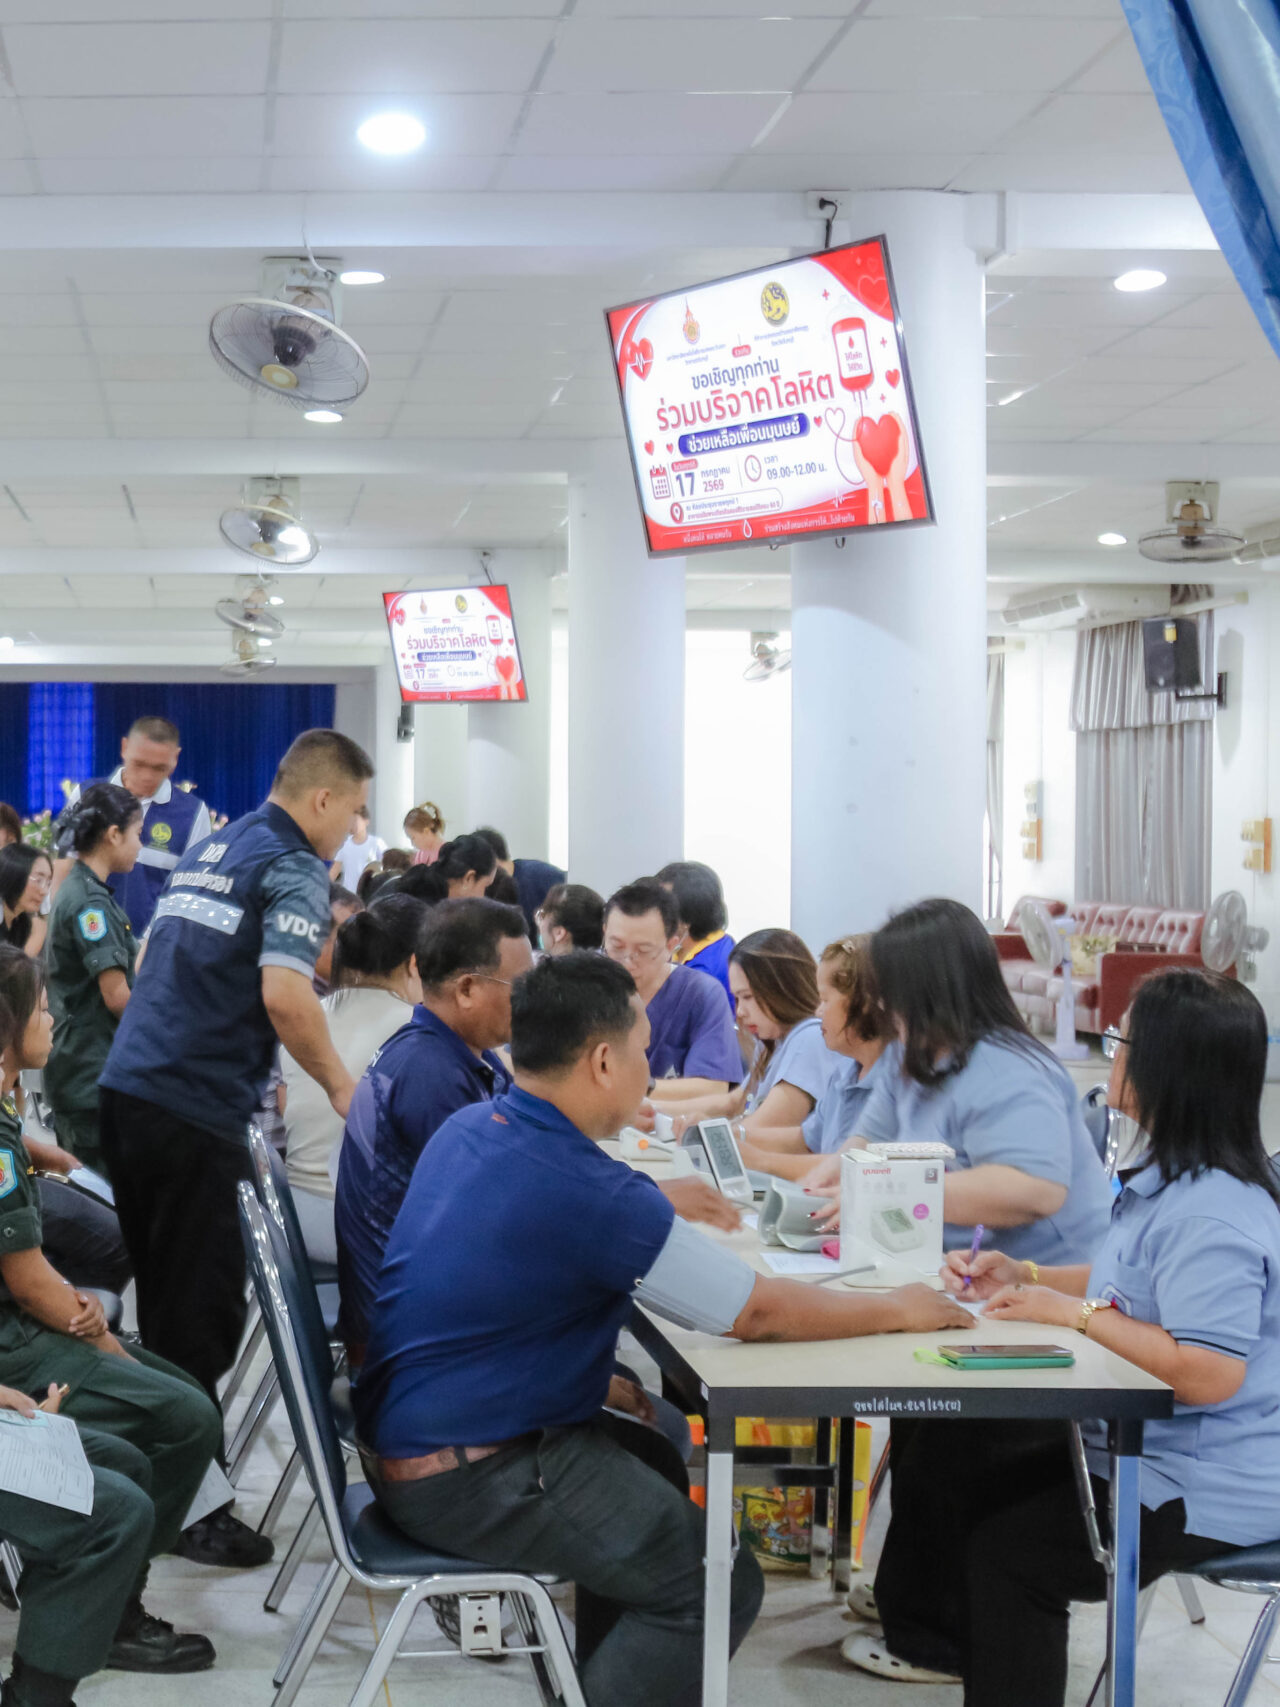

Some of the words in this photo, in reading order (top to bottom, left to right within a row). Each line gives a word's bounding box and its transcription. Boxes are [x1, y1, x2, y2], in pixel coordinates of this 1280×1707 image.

[692, 356, 780, 390] ขอเชิญทุกท่าน
[657, 370, 835, 431] ร่วมบริจาคโลหิต
[764, 455, 779, 464] เวลา
[701, 466, 731, 478] กรกฎาคม
[767, 462, 817, 480] 09.00-12.00
[819, 463, 827, 472] น.
[675, 472, 695, 497] 17
[703, 479, 724, 492] 2569
[407, 633, 487, 650] ร่วมบริจาคโลหิต
[415, 669, 424, 679] 17
[277, 913, 320, 942] VDC
